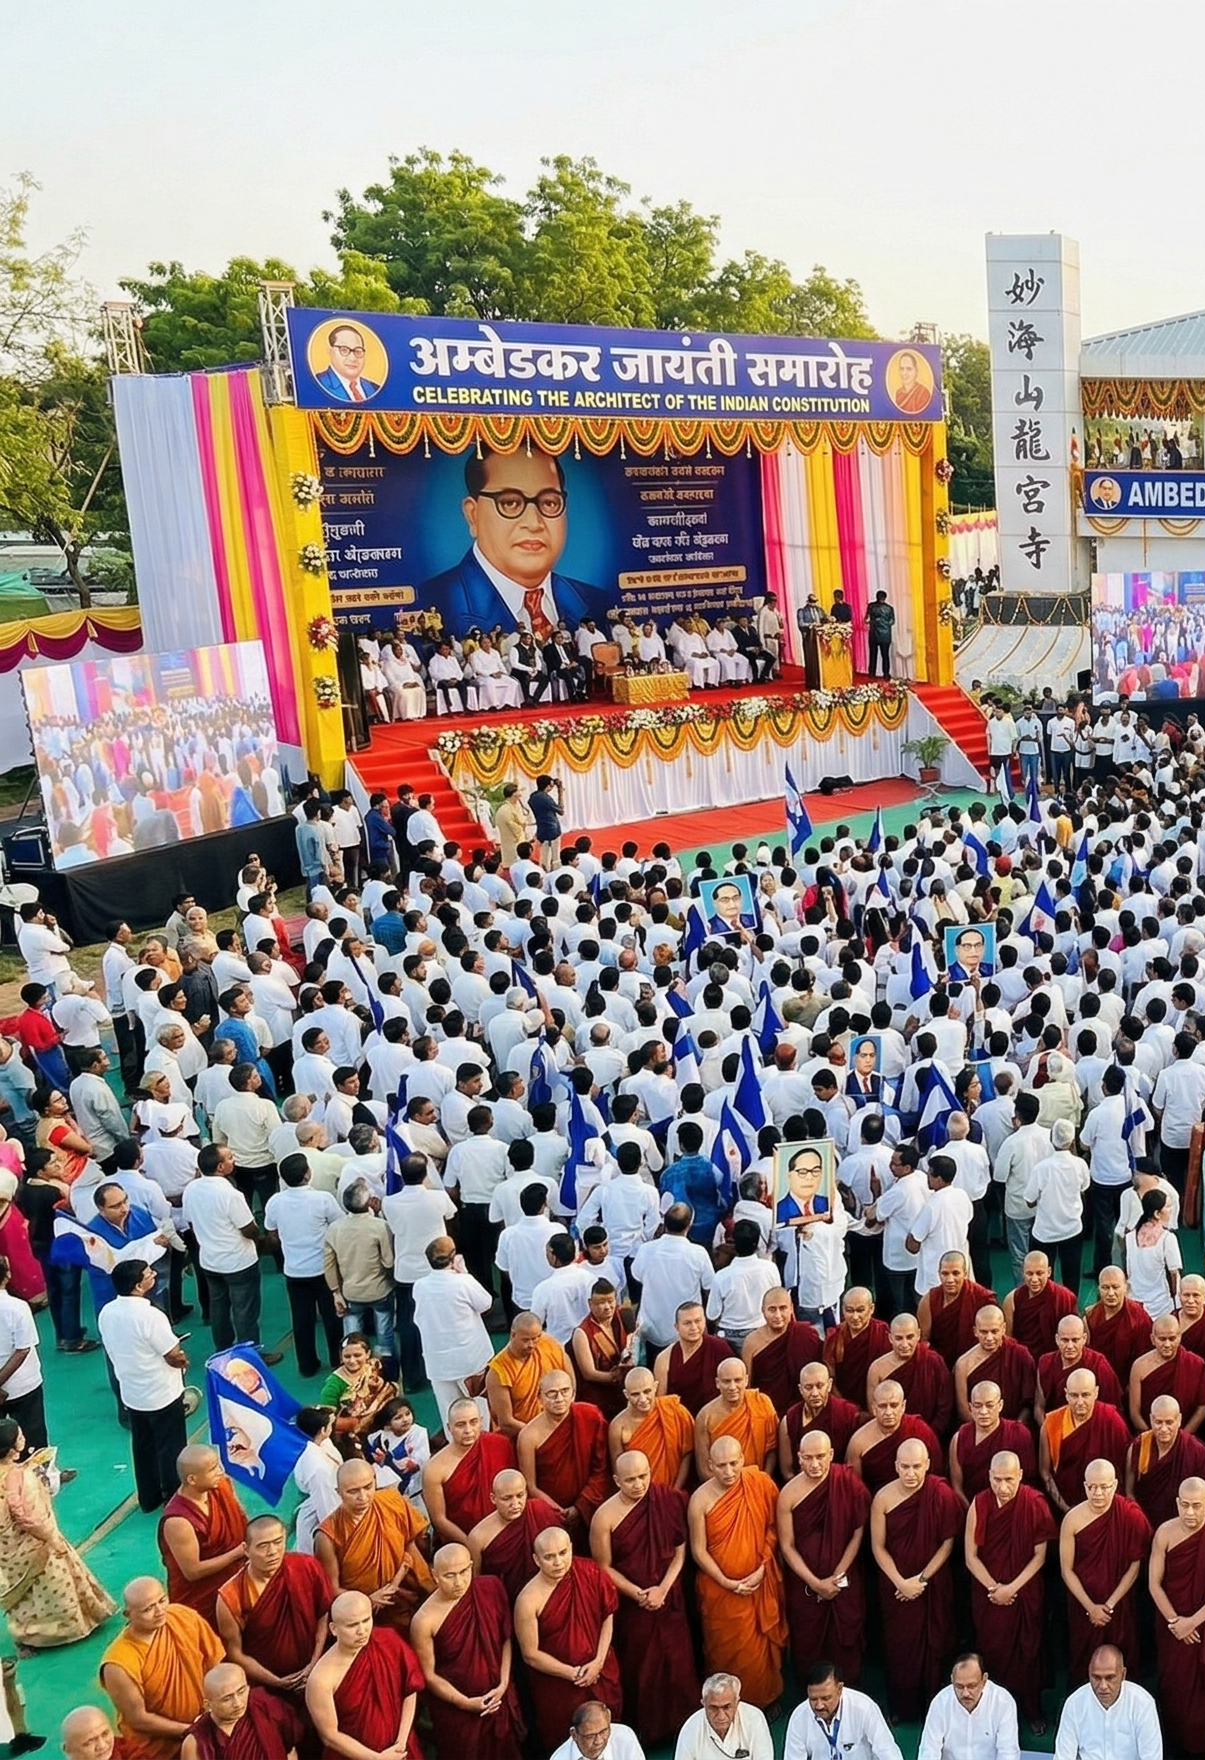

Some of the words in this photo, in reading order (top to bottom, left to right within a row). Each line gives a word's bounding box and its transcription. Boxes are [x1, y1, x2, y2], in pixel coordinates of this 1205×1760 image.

[409, 324, 602, 382] अम्बेडकर
[610, 336, 737, 386] जायंती
[745, 341, 873, 395] समारोह
[412, 386, 533, 407] CELEBRATING
[536, 390, 571, 407] THE
[574, 391, 661, 409] ARCHITECT
[664, 394, 685, 410] OF
[687, 394, 717, 411] THE
[720, 395, 769, 412] INDIAN
[772, 396, 871, 413] CONSTITUTION
[1004, 267, 1051, 570] 妙海山龍宮寺
